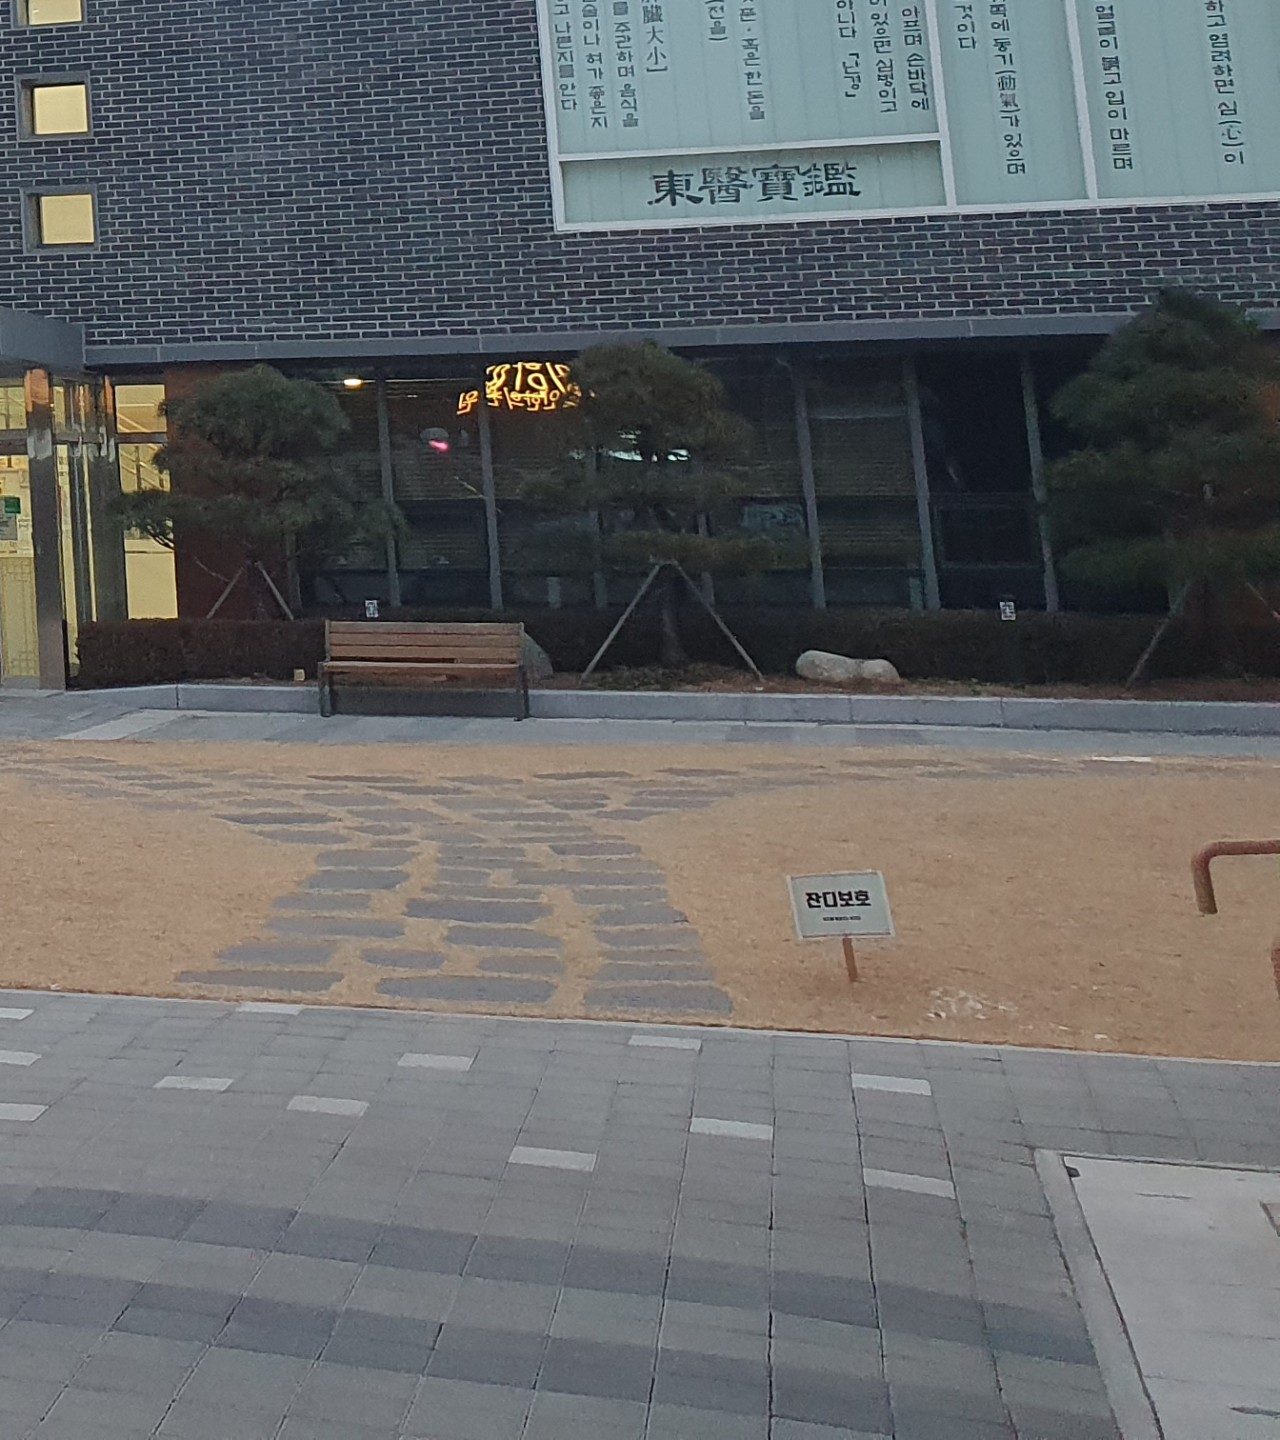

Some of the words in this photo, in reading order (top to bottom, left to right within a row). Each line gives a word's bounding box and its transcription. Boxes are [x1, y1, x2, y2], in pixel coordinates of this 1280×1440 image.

[870, 12, 892, 54] 있으면
[901, 5, 922, 46] 아프며
[953, 4, 976, 49] 것이다
[1095, 4, 1118, 50] 얼굴이
[585, 52, 603, 80] 혀가
[744, 70, 763, 86] 한
[906, 52, 929, 110] 손바닥에
[1208, 32, 1235, 94] 염려하면
[559, 82, 577, 110] 안다
[588, 85, 608, 128] 좋은지
[619, 83, 639, 127] 음식을
[875, 57, 898, 113] 심병이고
[1104, 89, 1127, 120] 입이
[1003, 132, 1025, 174] 있으며
[1109, 127, 1133, 170] 마르며
[647, 161, 862, 207] 東醫寶鑑
[805, 890, 872, 909] 잔디보호
